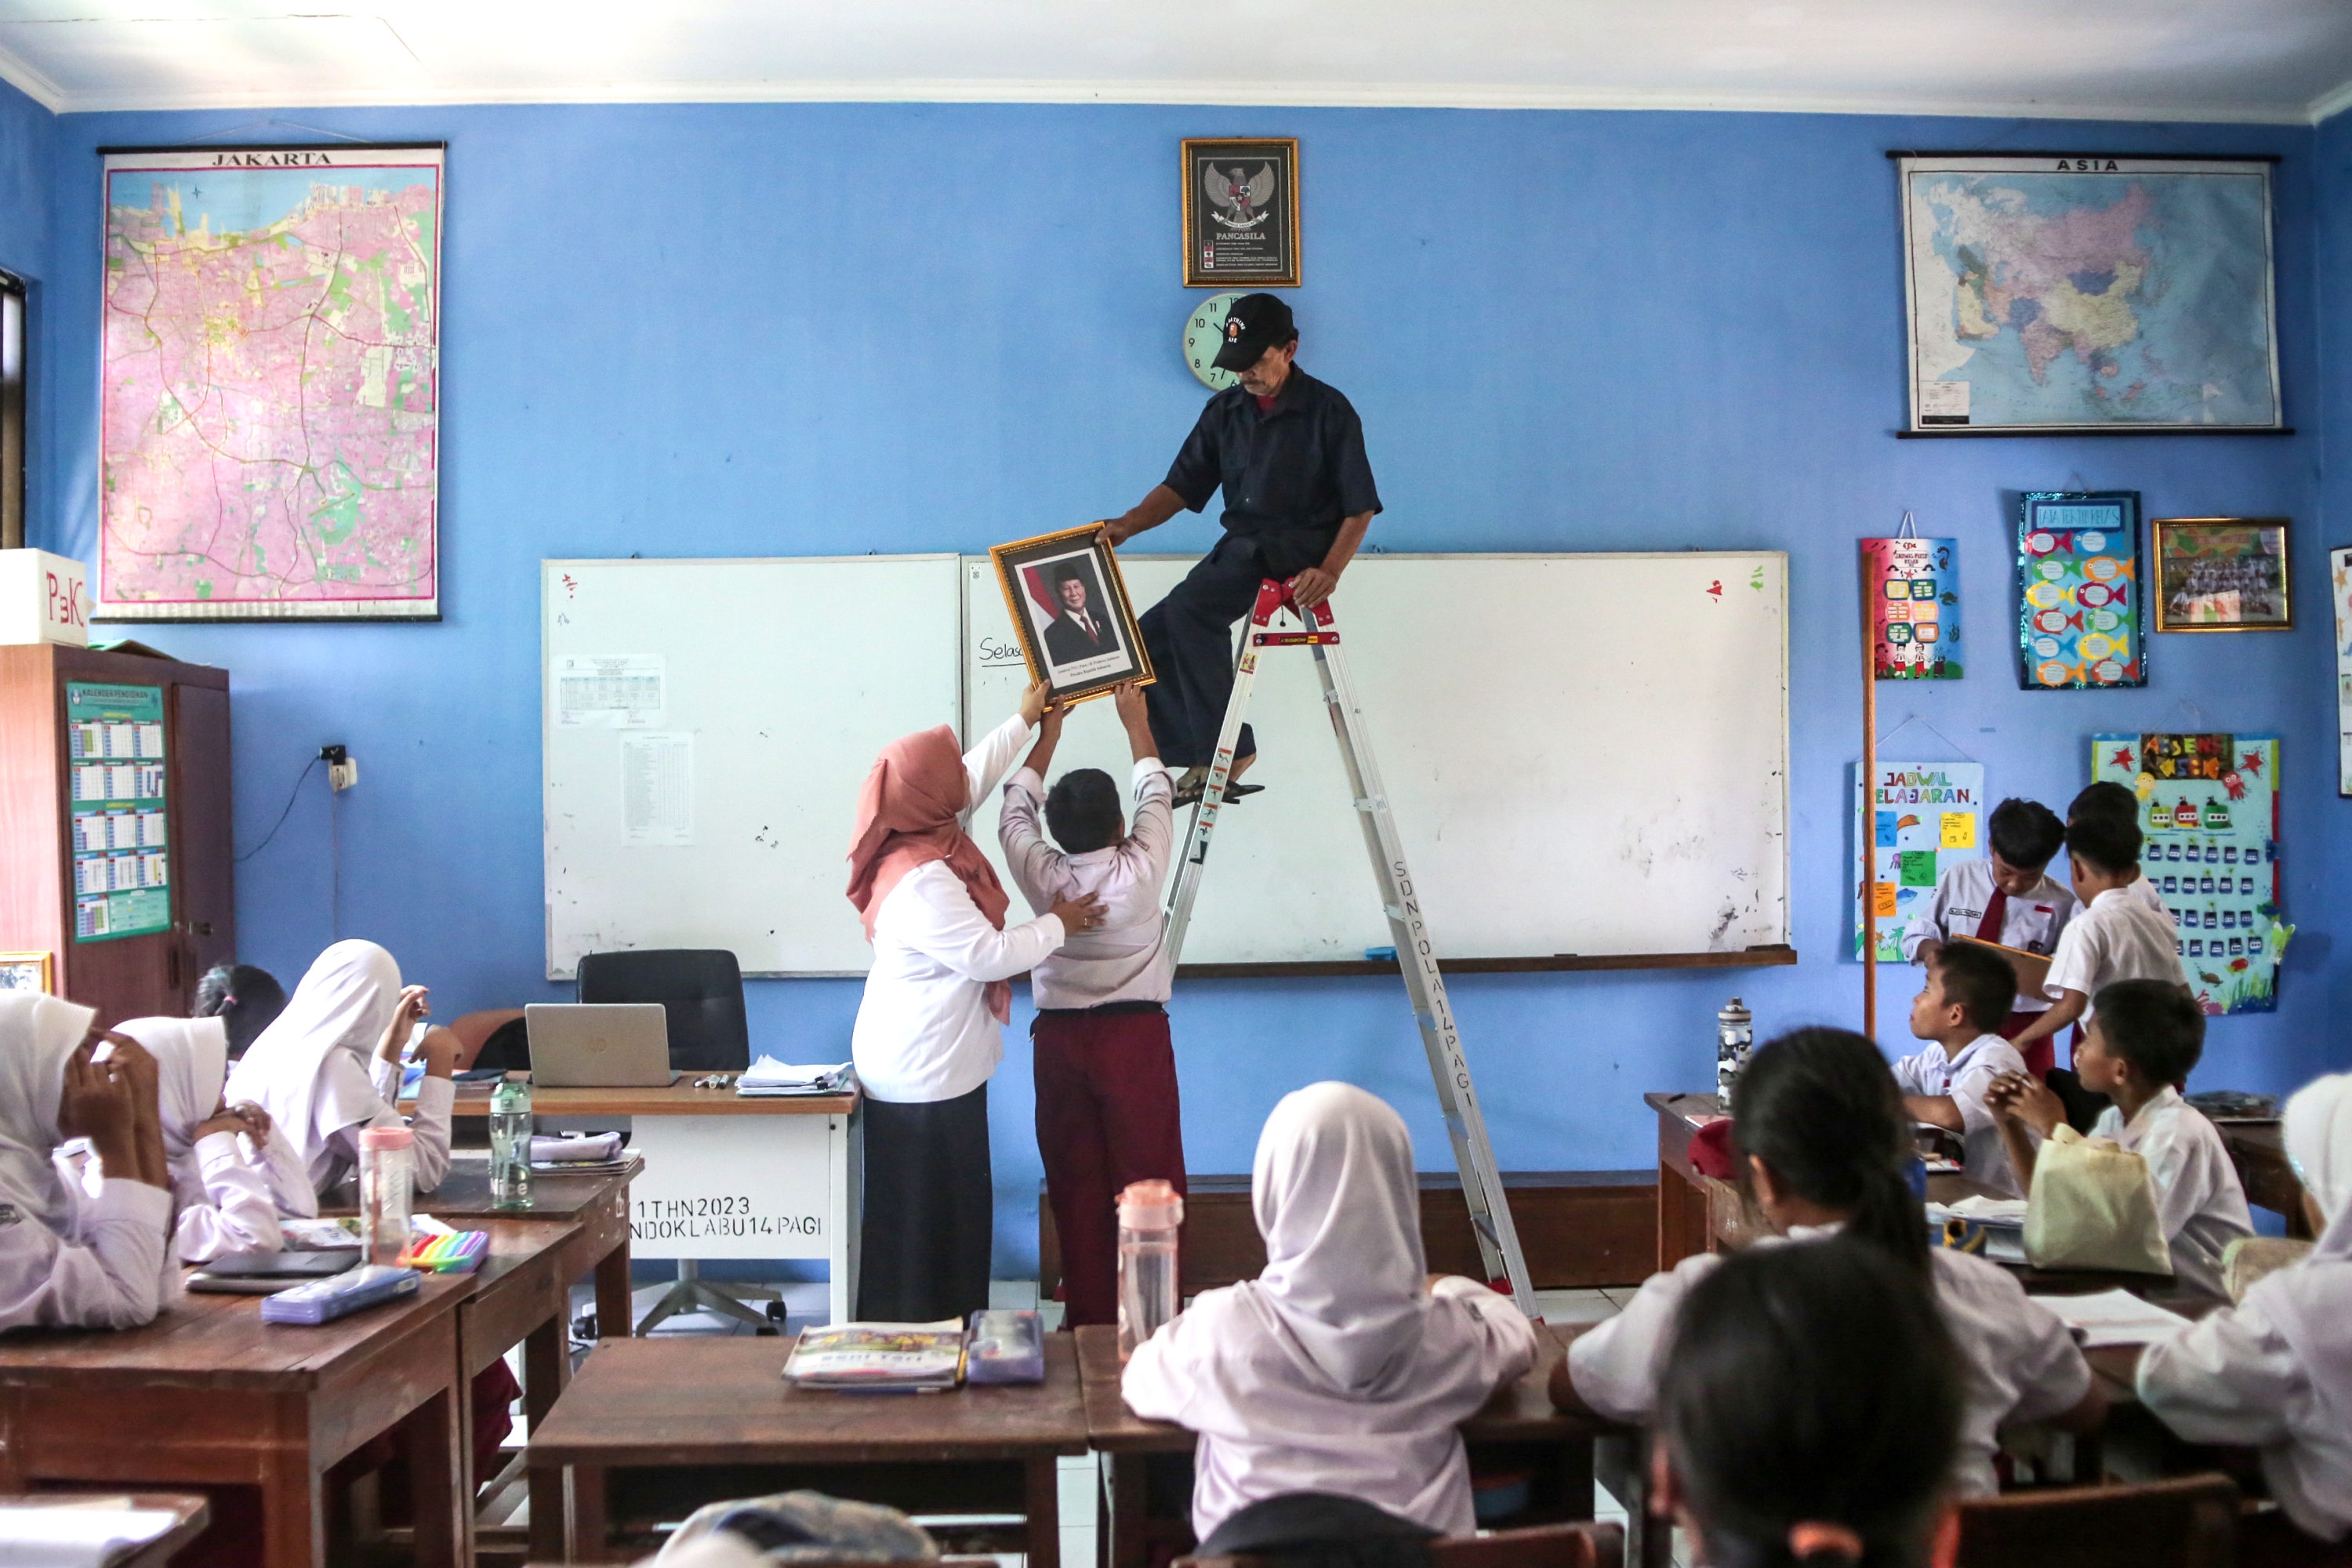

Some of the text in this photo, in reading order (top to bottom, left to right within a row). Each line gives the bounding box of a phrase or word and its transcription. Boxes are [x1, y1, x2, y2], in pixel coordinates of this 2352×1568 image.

[212, 153, 332, 165] JAKARTA
[2057, 159, 2118, 171] ASIA
[1210, 303, 1217, 312] 11
[1195, 318, 1205, 328] 10
[1189, 338, 1195, 347] 9
[1195, 359, 1200, 368] 8
[1210, 373, 1216, 382] 7
[1883, 772, 1953, 786] JADWAL
[1875, 789, 1969, 804] ELAJARAN
